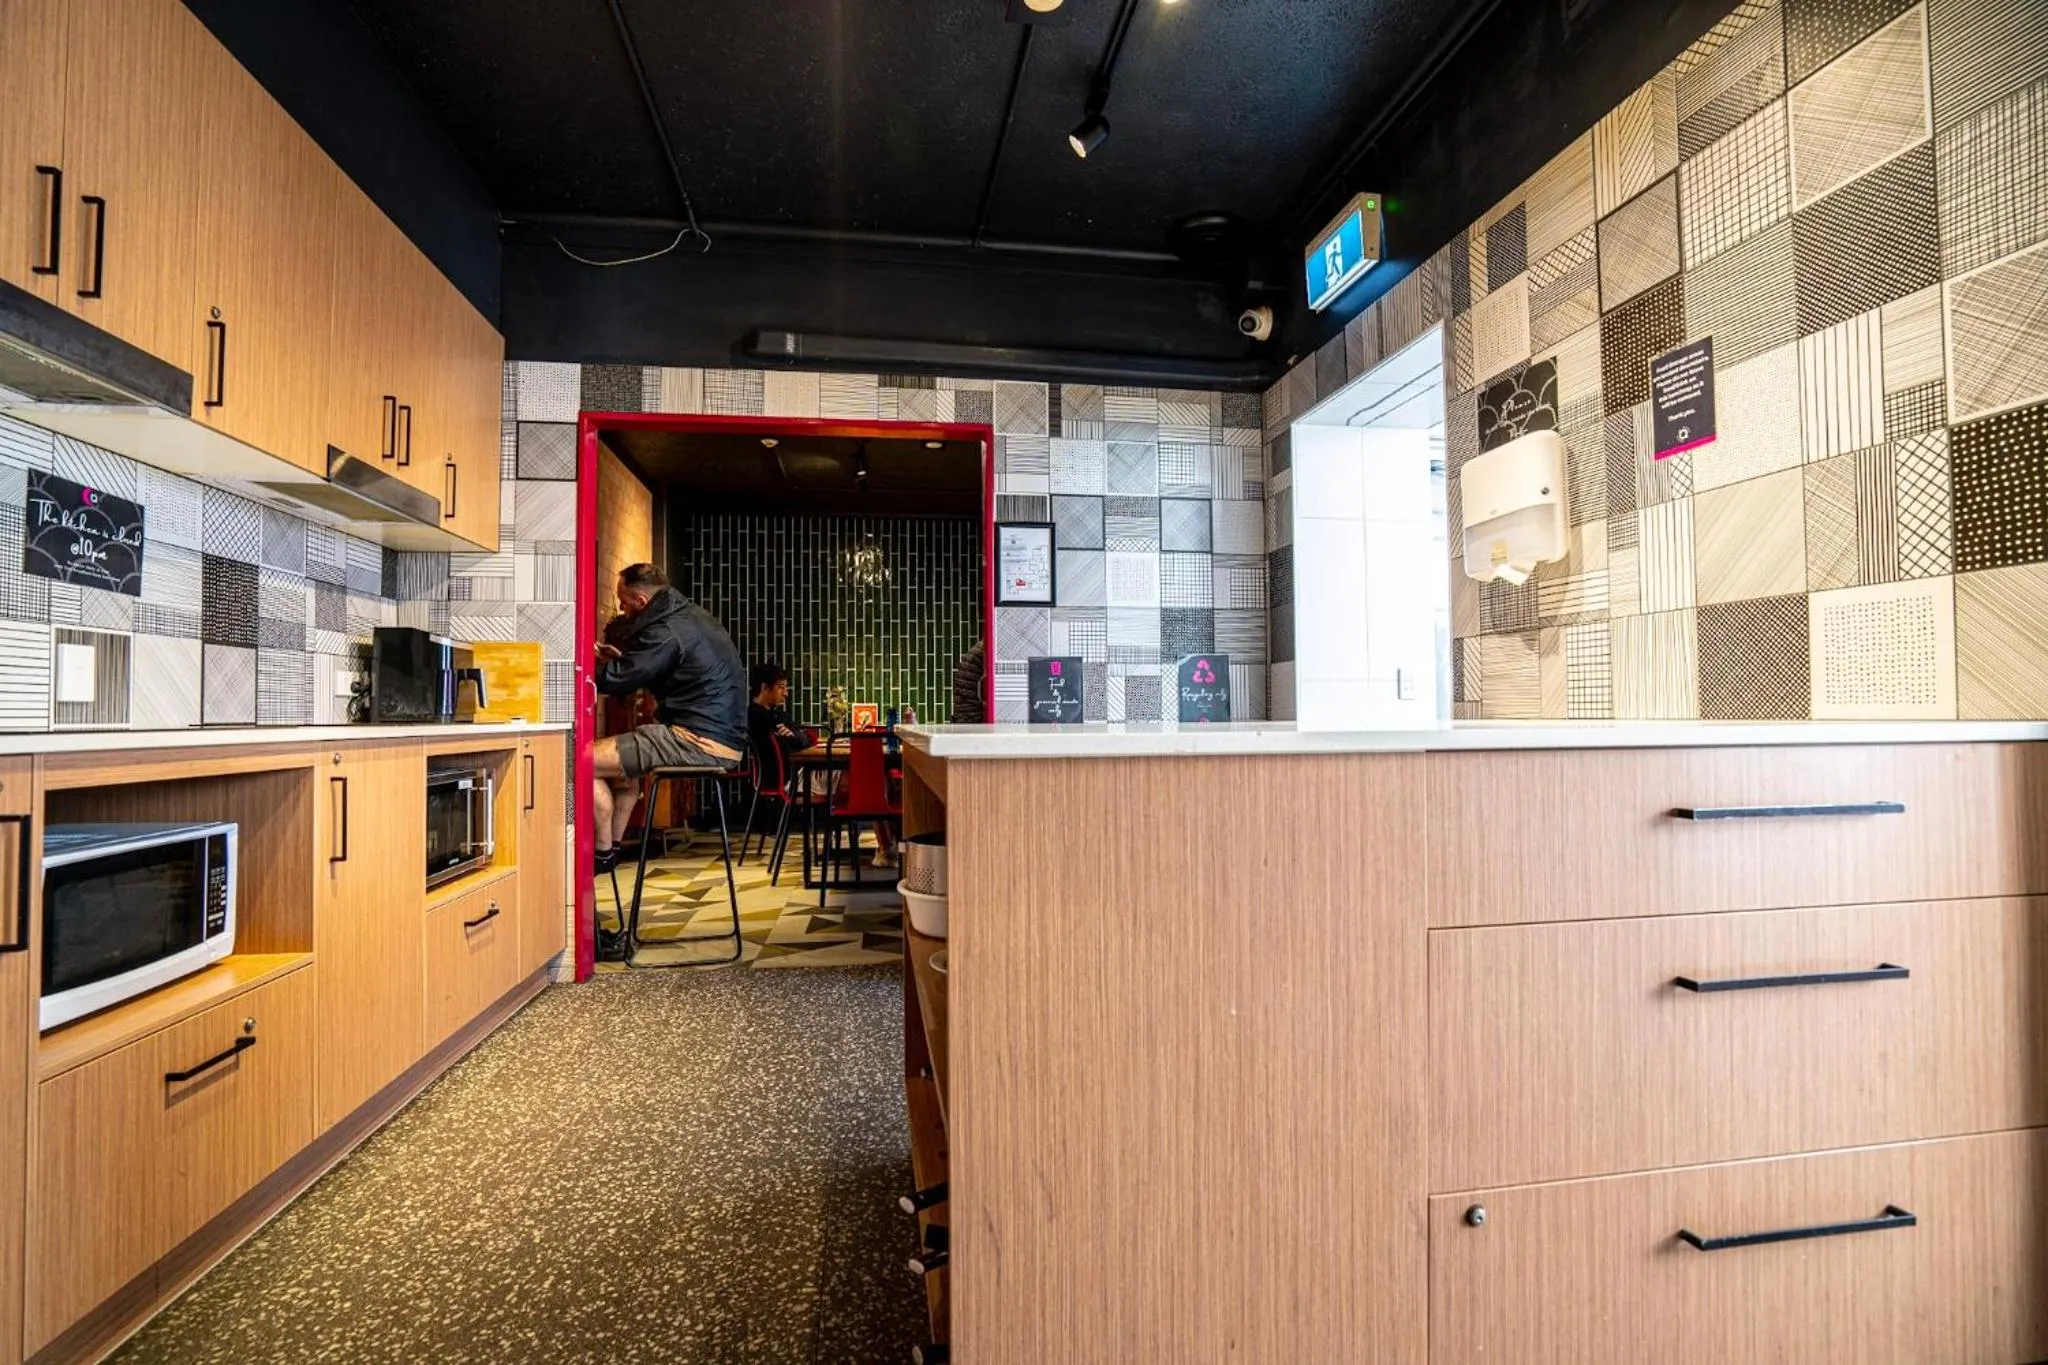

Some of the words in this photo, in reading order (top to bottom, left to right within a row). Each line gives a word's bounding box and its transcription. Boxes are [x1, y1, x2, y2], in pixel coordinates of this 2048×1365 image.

[29, 498, 58, 526] The
[62, 509, 100, 536] kitchen
[102, 530, 109, 539] is
[112, 525, 142, 547] closed
